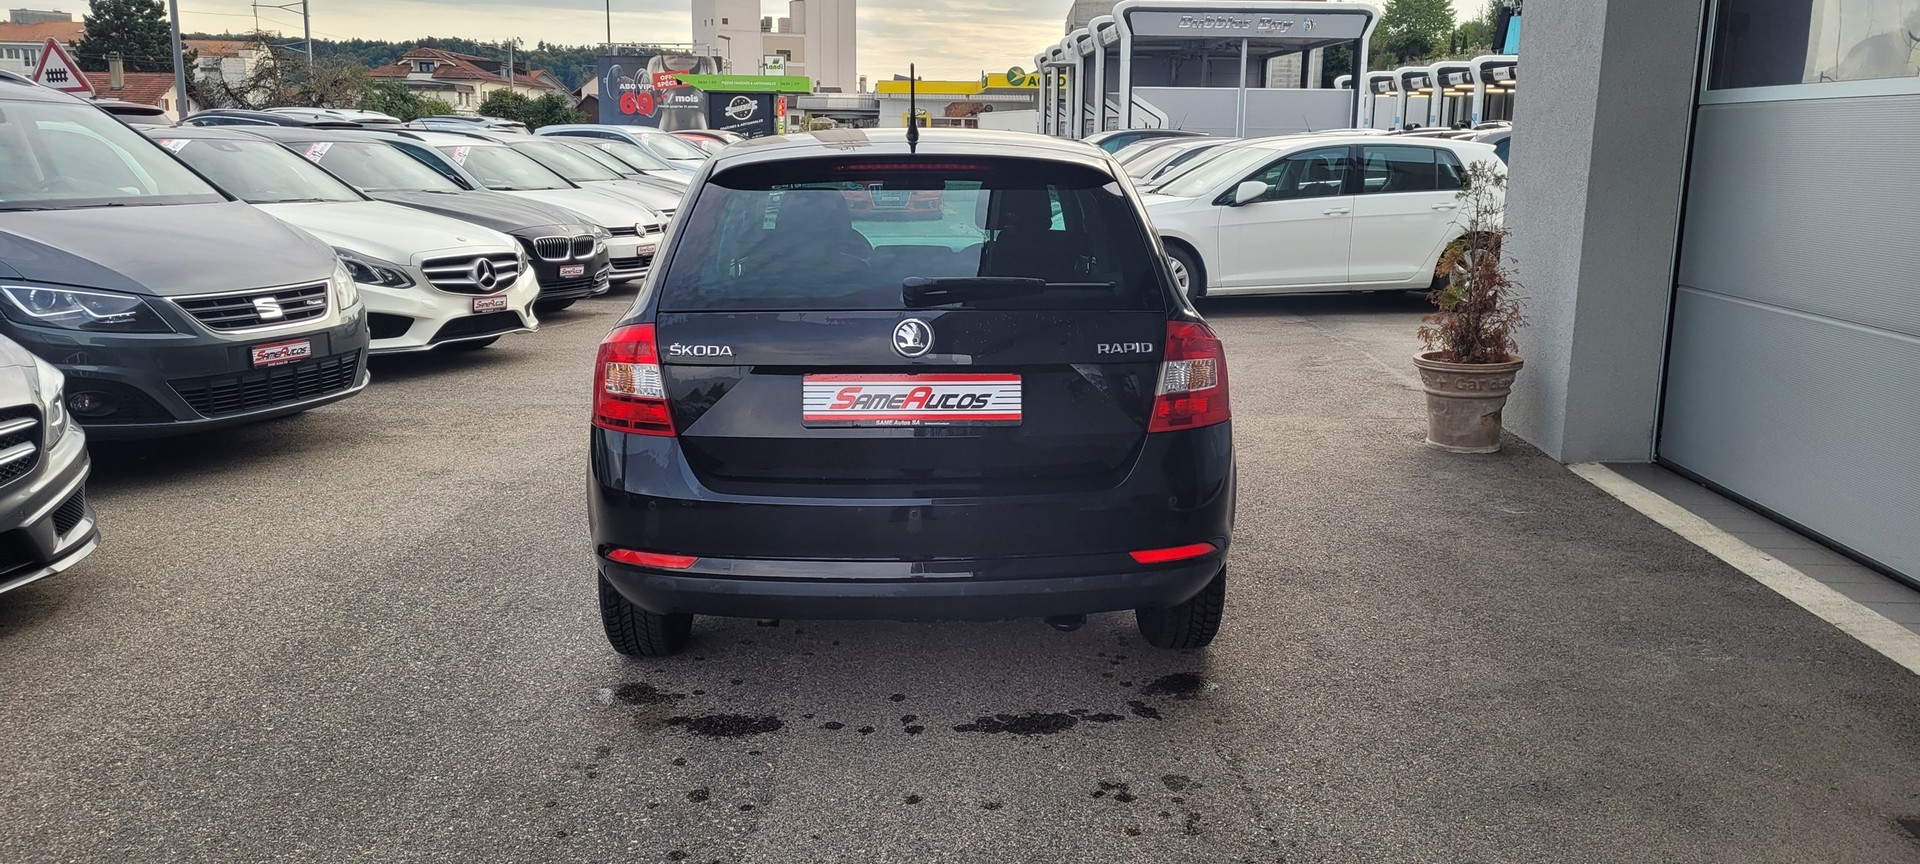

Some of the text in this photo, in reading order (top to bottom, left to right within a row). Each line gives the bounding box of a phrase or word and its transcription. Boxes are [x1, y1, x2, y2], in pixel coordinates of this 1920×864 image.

[1178, 15, 1295, 33] Bubbles Bay
[675, 94, 699, 103] mois
[669, 342, 733, 356] ŠKODA
[1097, 342, 1153, 354] RAPID
[875, 419, 893, 427] SAME
[893, 419, 911, 427] Autos
